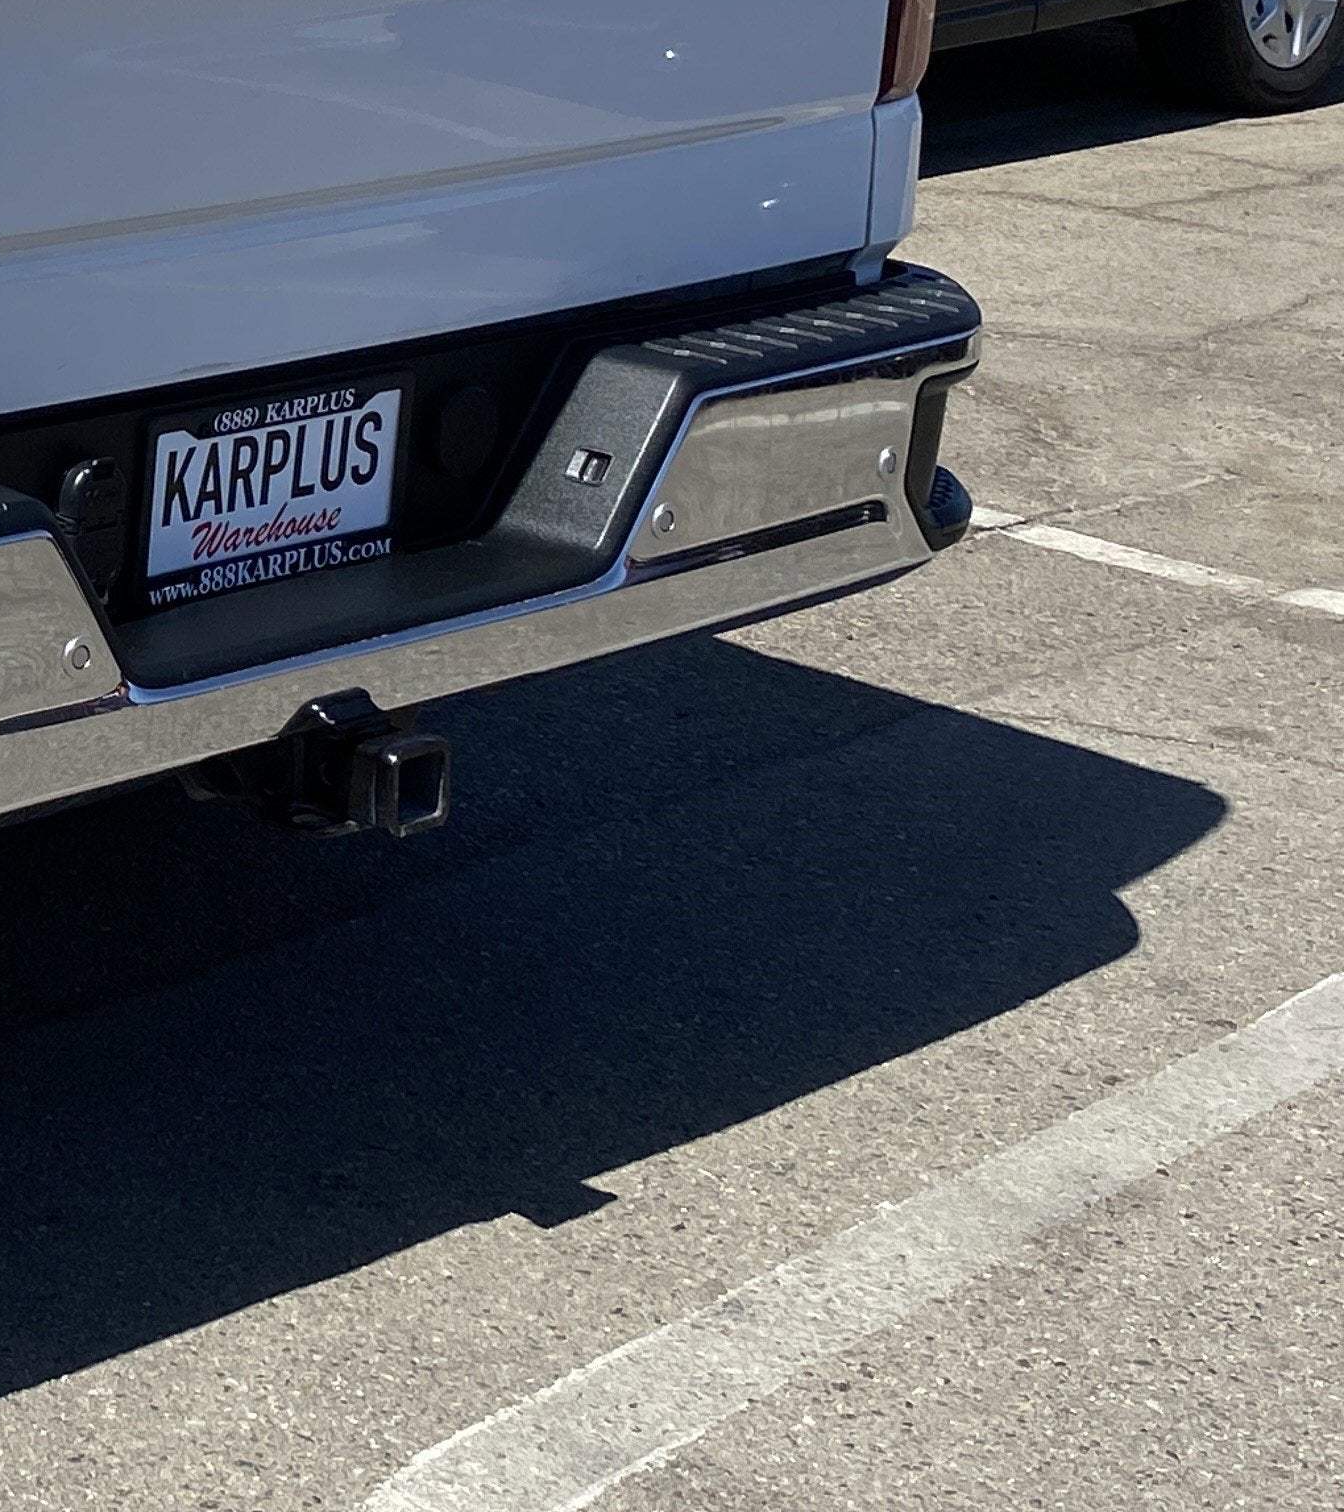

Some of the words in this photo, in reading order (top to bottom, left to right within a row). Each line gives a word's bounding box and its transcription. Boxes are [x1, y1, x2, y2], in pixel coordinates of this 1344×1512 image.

[213, 407, 260, 433] (888)
[264, 388, 356, 424] KARPLUS
[161, 411, 383, 528] KARPLUS
[191, 502, 342, 560] Warehouse
